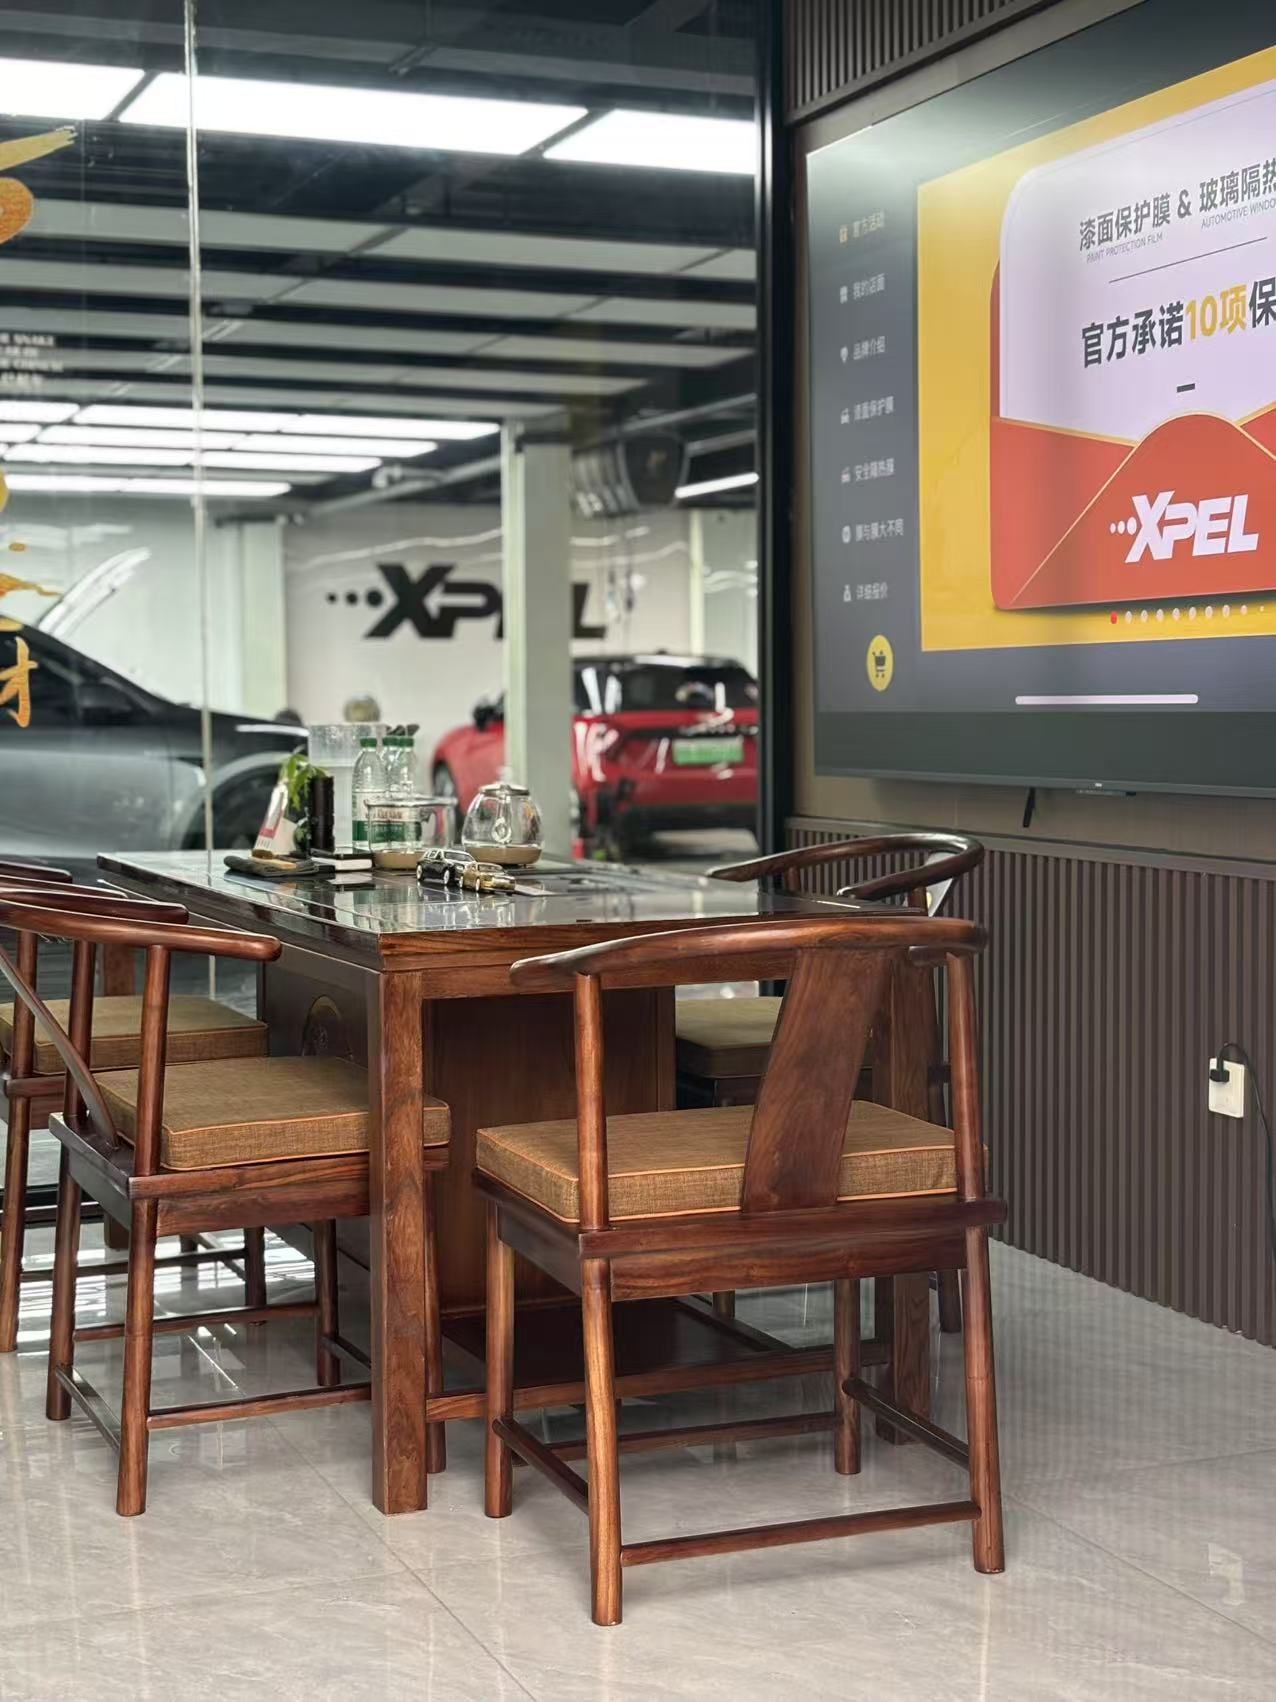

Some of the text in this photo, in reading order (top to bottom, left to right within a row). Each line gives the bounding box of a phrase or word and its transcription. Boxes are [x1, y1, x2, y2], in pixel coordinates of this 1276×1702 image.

[1080, 192, 1171, 251] 漆面保护膜
[1177, 188, 1192, 219] &
[1105, 237, 1146, 257] PROTECTION
[1147, 232, 1163, 245] FILM
[1201, 205, 1249, 230] AUTOMOTIVE
[1125, 490, 1259, 563] XPEL
[363, 563, 608, 640] XPL
